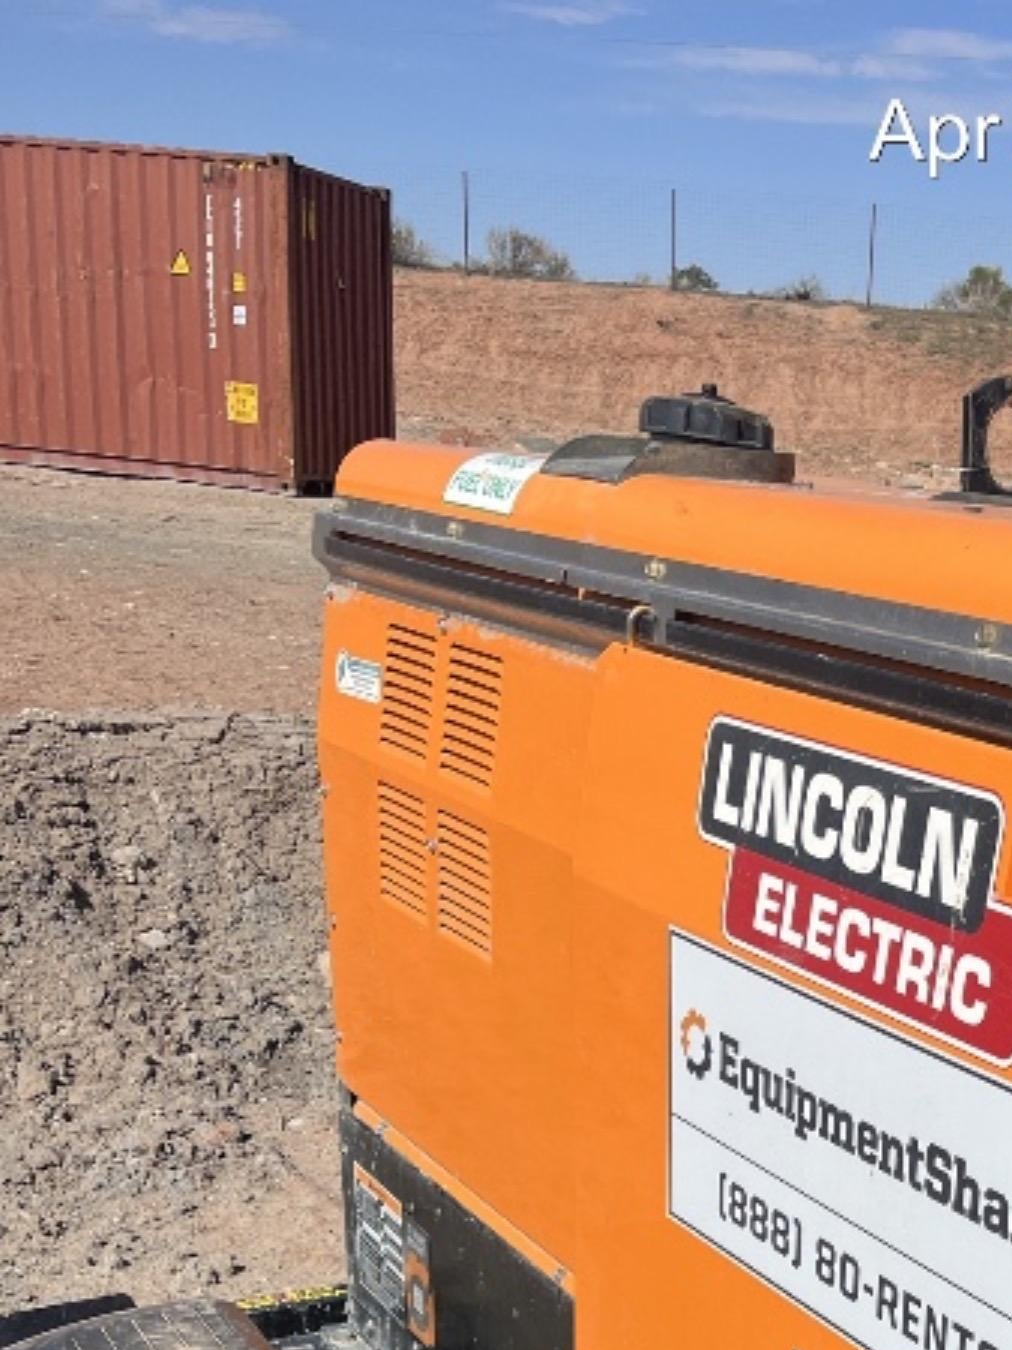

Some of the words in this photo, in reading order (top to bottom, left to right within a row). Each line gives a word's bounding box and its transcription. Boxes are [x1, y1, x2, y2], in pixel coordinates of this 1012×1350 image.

[712, 743, 980, 910] LINCOLN
[752, 875, 992, 1026] ELECTRIC
[719, 1172, 801, 1270] (888)
